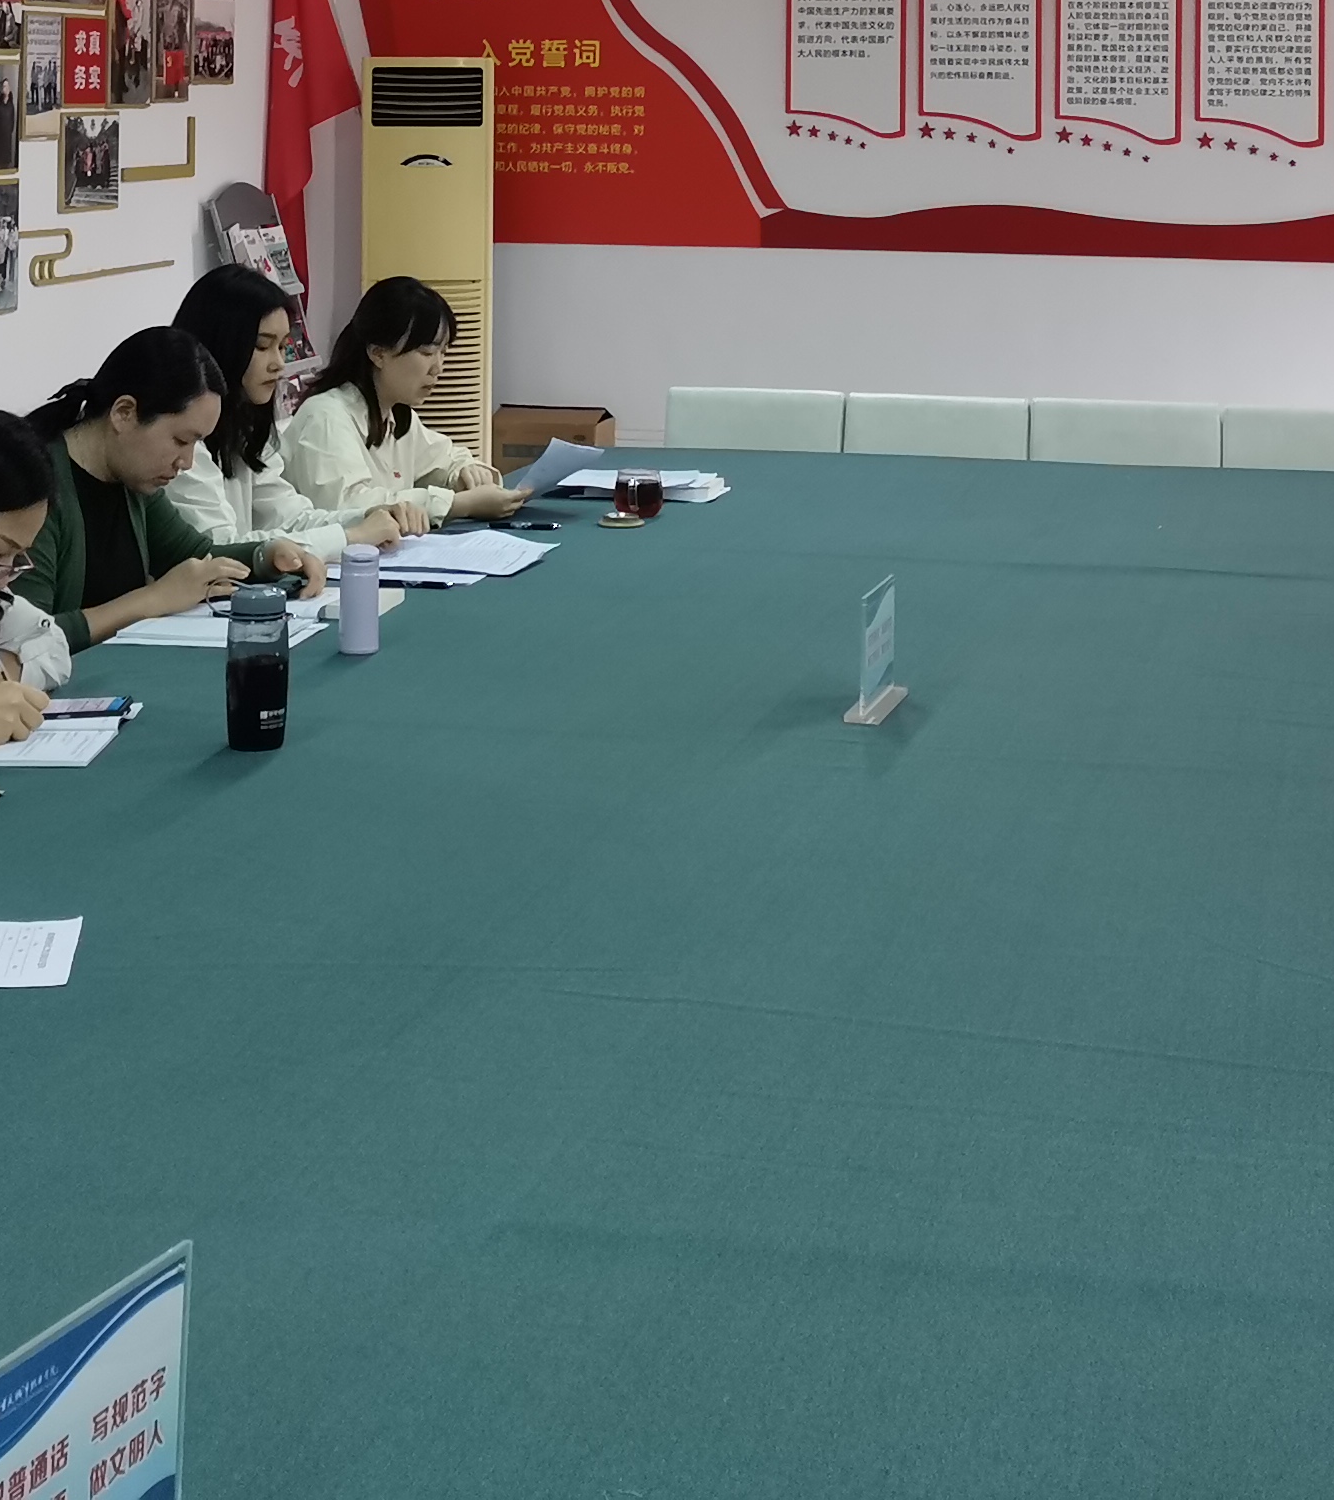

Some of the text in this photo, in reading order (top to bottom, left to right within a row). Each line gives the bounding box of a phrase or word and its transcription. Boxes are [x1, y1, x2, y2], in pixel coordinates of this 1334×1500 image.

[74, 30, 101, 55] 求真
[482, 39, 601, 68] 入党誓词
[74, 65, 101, 90] 务实
[91, 1366, 167, 1444] 写规范字
[89, 1419, 165, 1500] 做文明人
